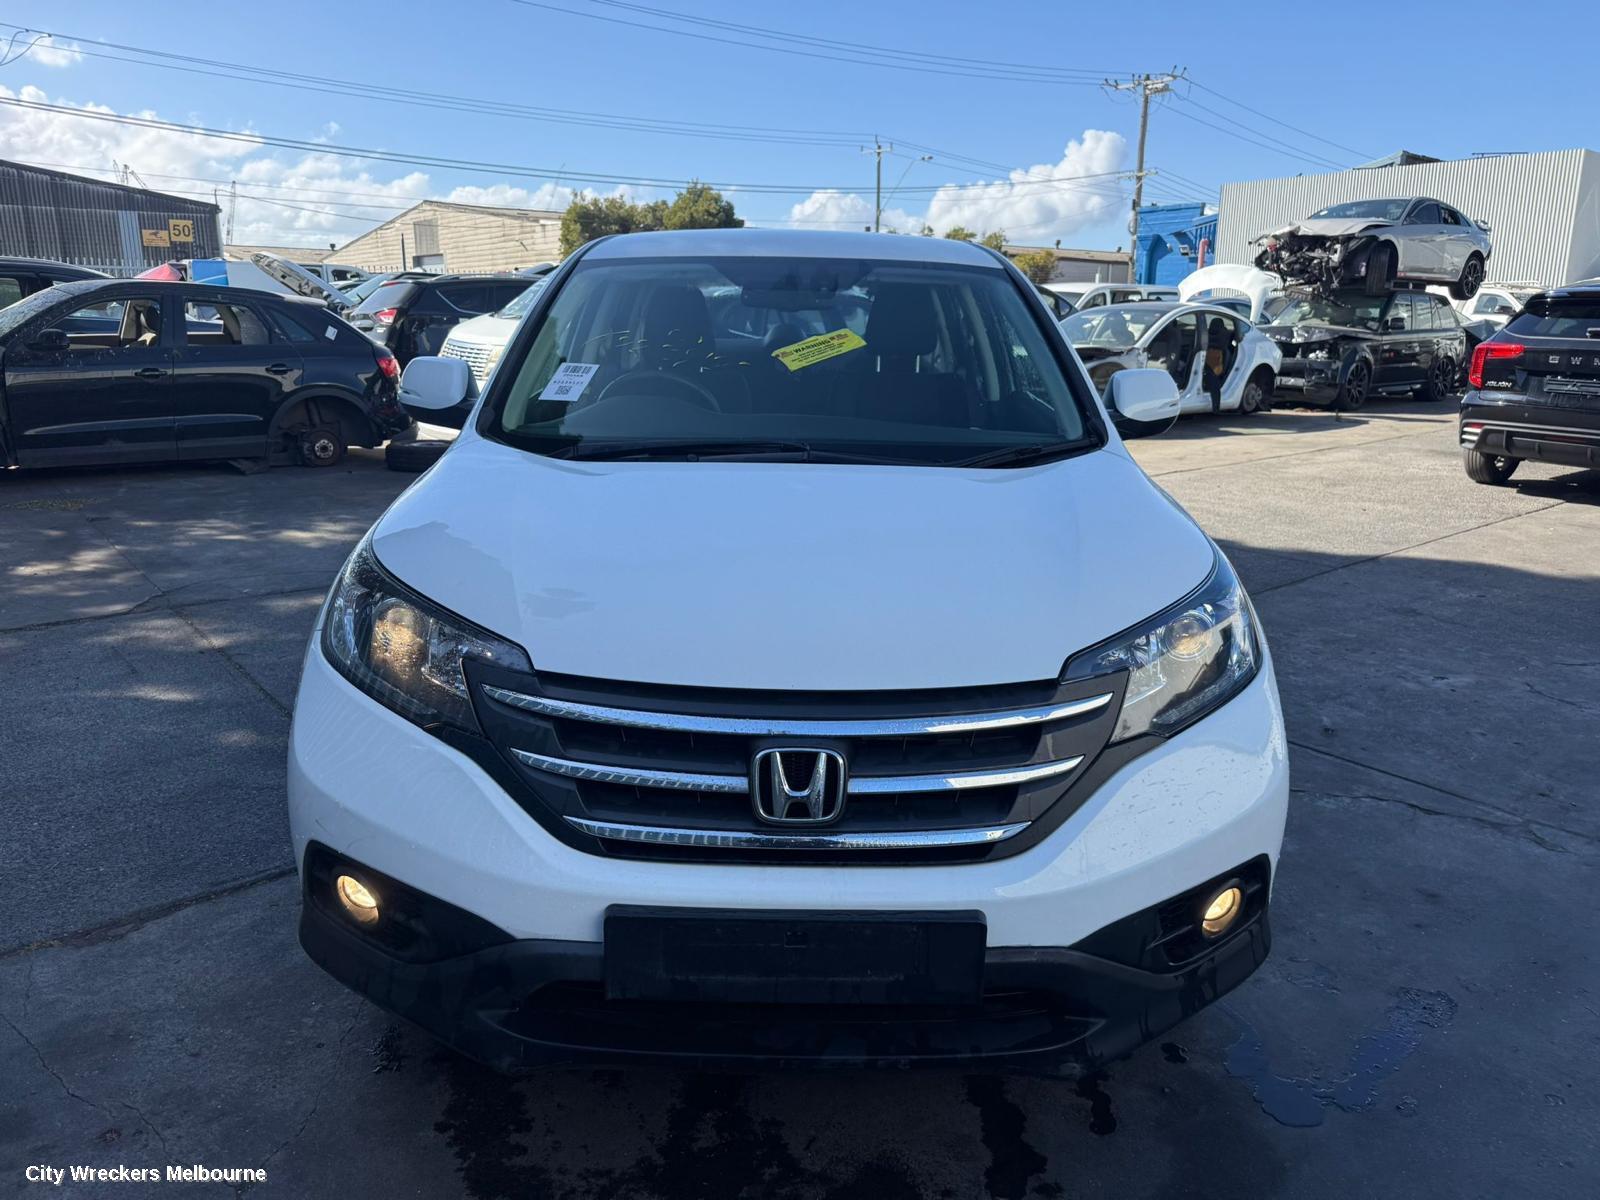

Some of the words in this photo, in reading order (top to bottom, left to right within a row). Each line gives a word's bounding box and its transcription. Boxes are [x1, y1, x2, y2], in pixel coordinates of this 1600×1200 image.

[172, 224, 191, 237] 50
[793, 340, 831, 353] WARNING
[1485, 380, 1512, 388] JOLION
